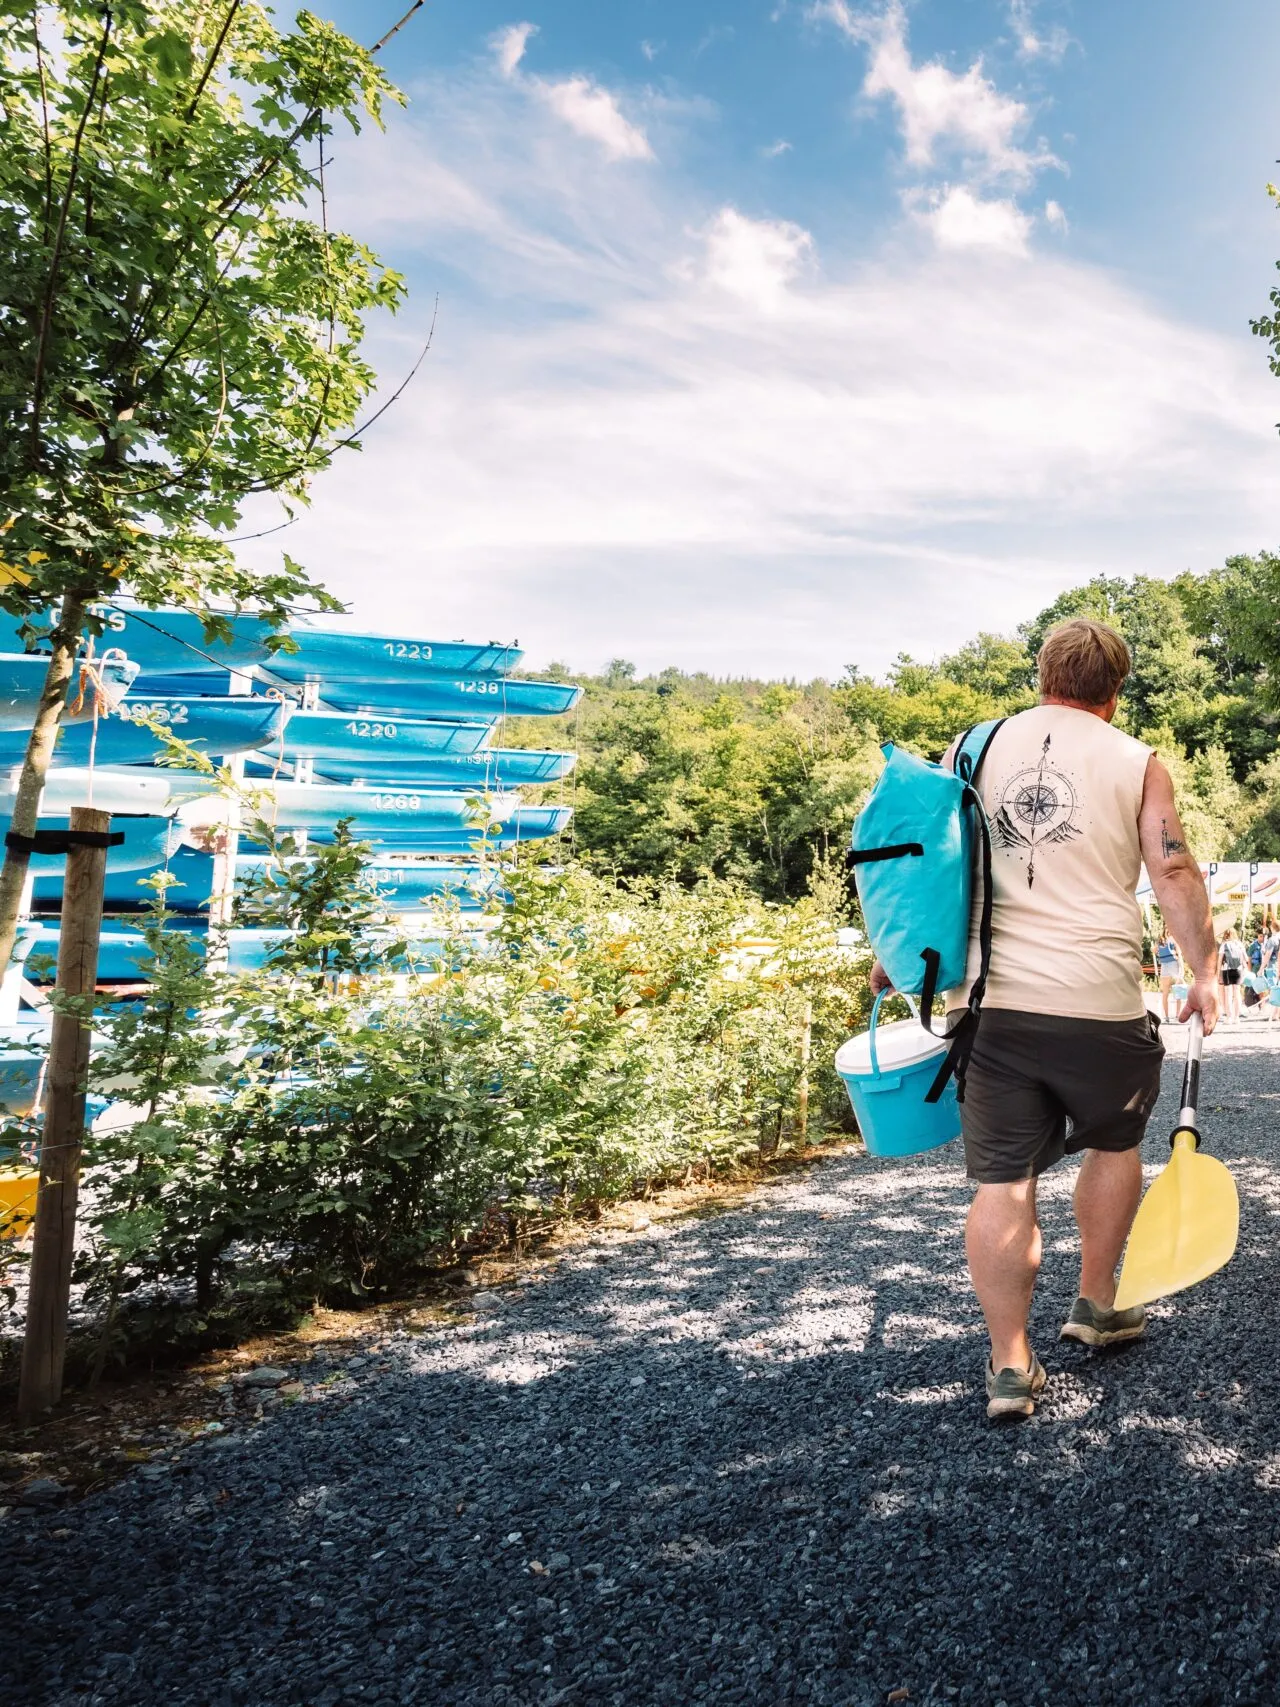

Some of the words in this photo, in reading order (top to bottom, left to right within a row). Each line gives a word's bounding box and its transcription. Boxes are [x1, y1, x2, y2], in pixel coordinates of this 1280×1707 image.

[383, 643, 433, 660] 1223
[455, 681, 499, 695] 1238
[346, 721, 398, 738] 1220
